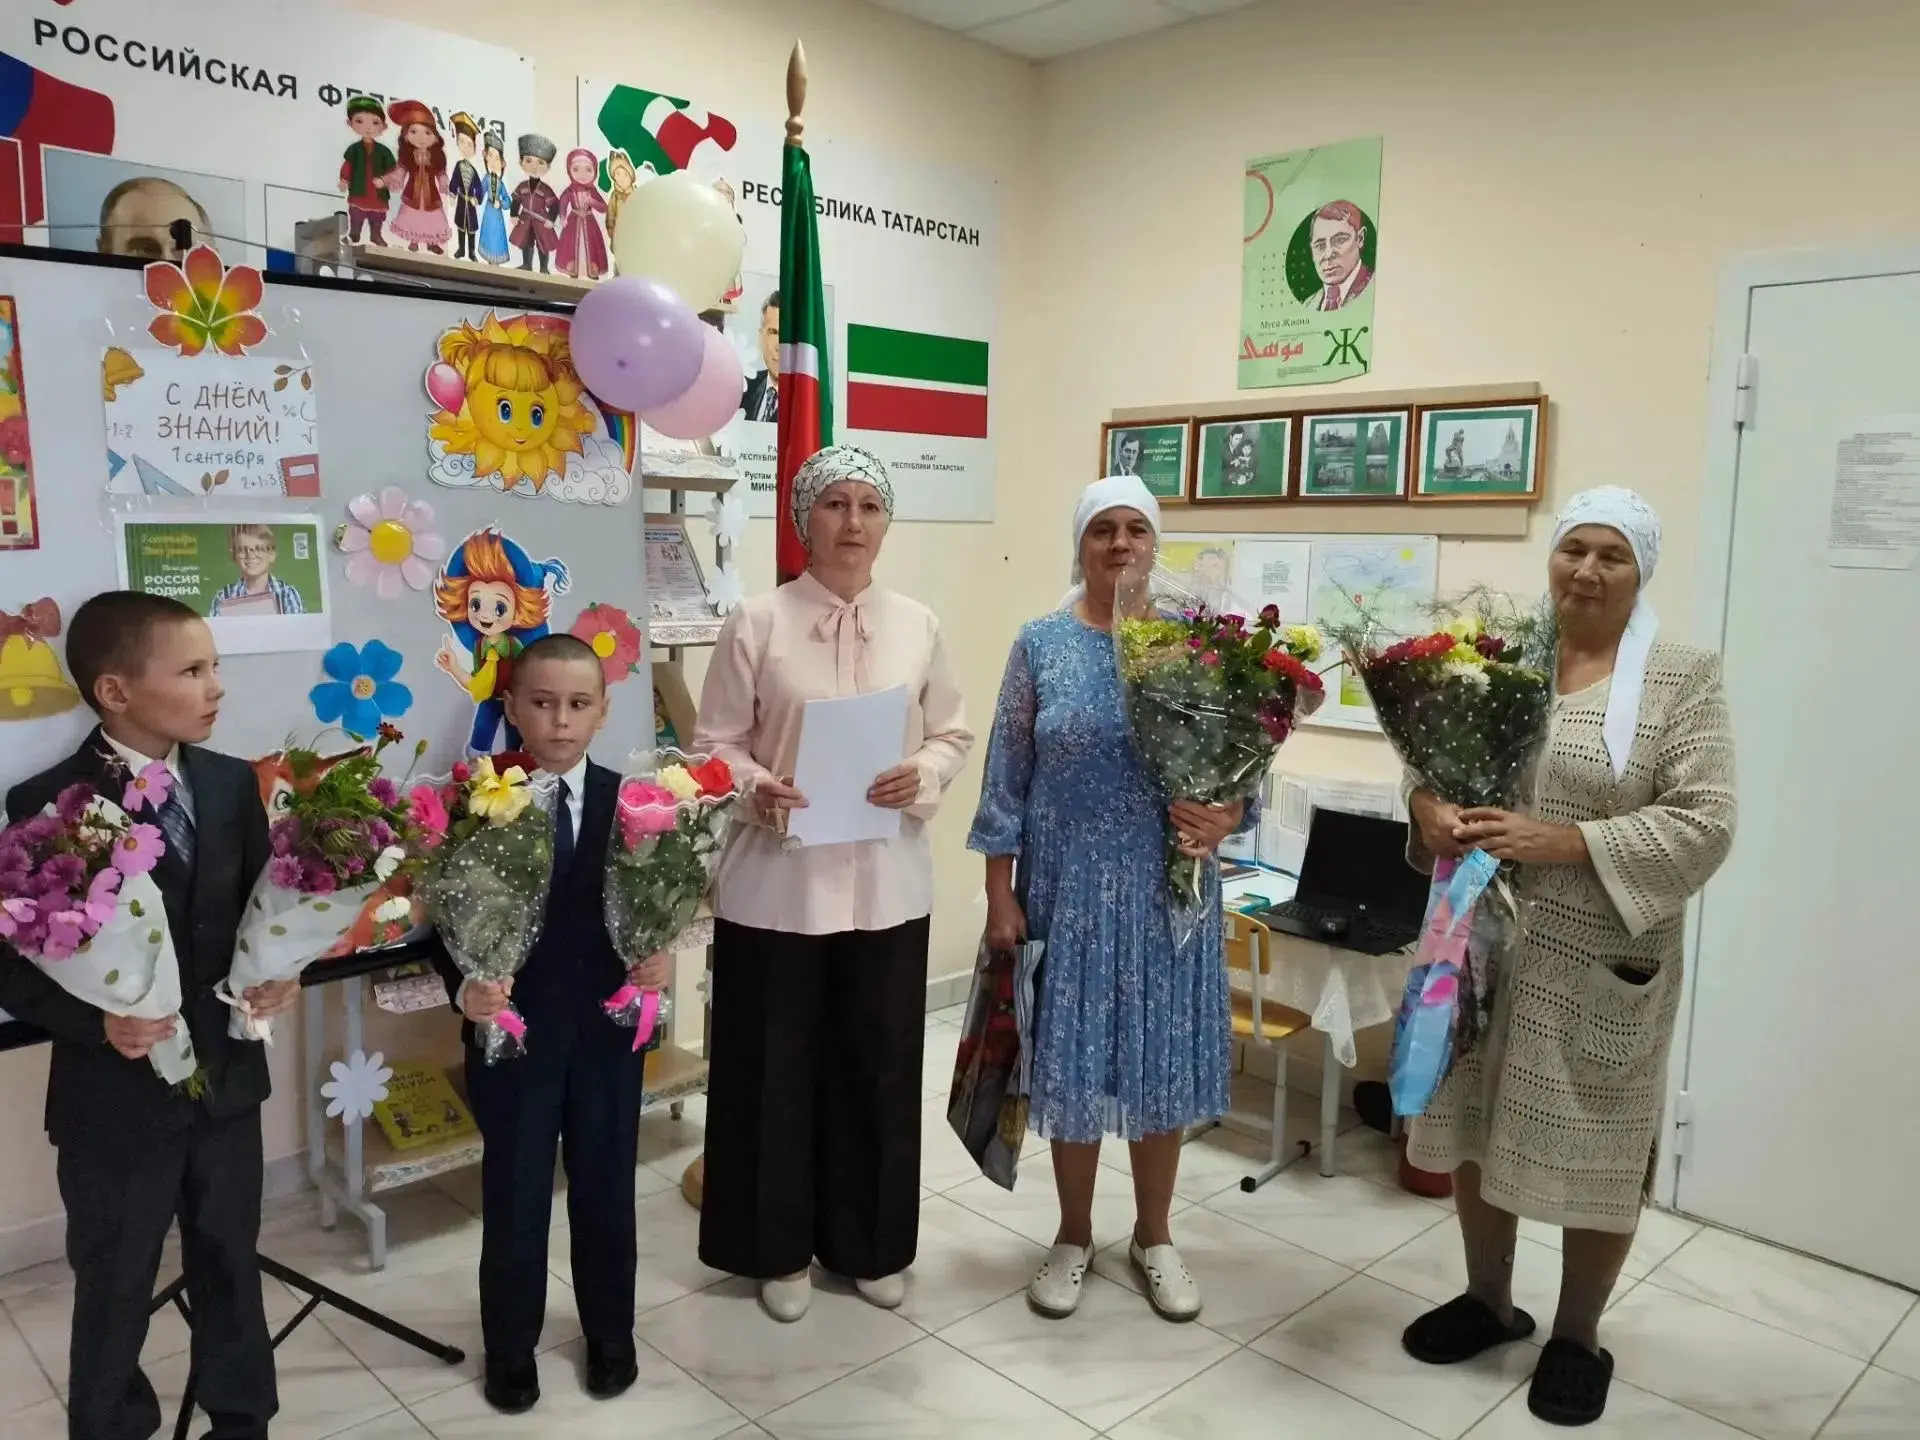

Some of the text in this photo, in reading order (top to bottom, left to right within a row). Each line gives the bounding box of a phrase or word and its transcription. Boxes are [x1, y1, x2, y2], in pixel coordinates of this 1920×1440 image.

[33, 17, 298, 100] РОССИЙСКАЯ
[742, 180, 980, 247] РЕСБЛИКА ТАТАРСТАН
[165, 381, 272, 413] С ДНЁМ
[157, 412, 281, 444] ЗНАНИЙ!
[171, 446, 265, 469] 1 сентября
[744, 470, 772, 481] Рустам
[144, 574, 201, 585] РОССИЯ
[144, 585, 201, 597] РОДИНА
